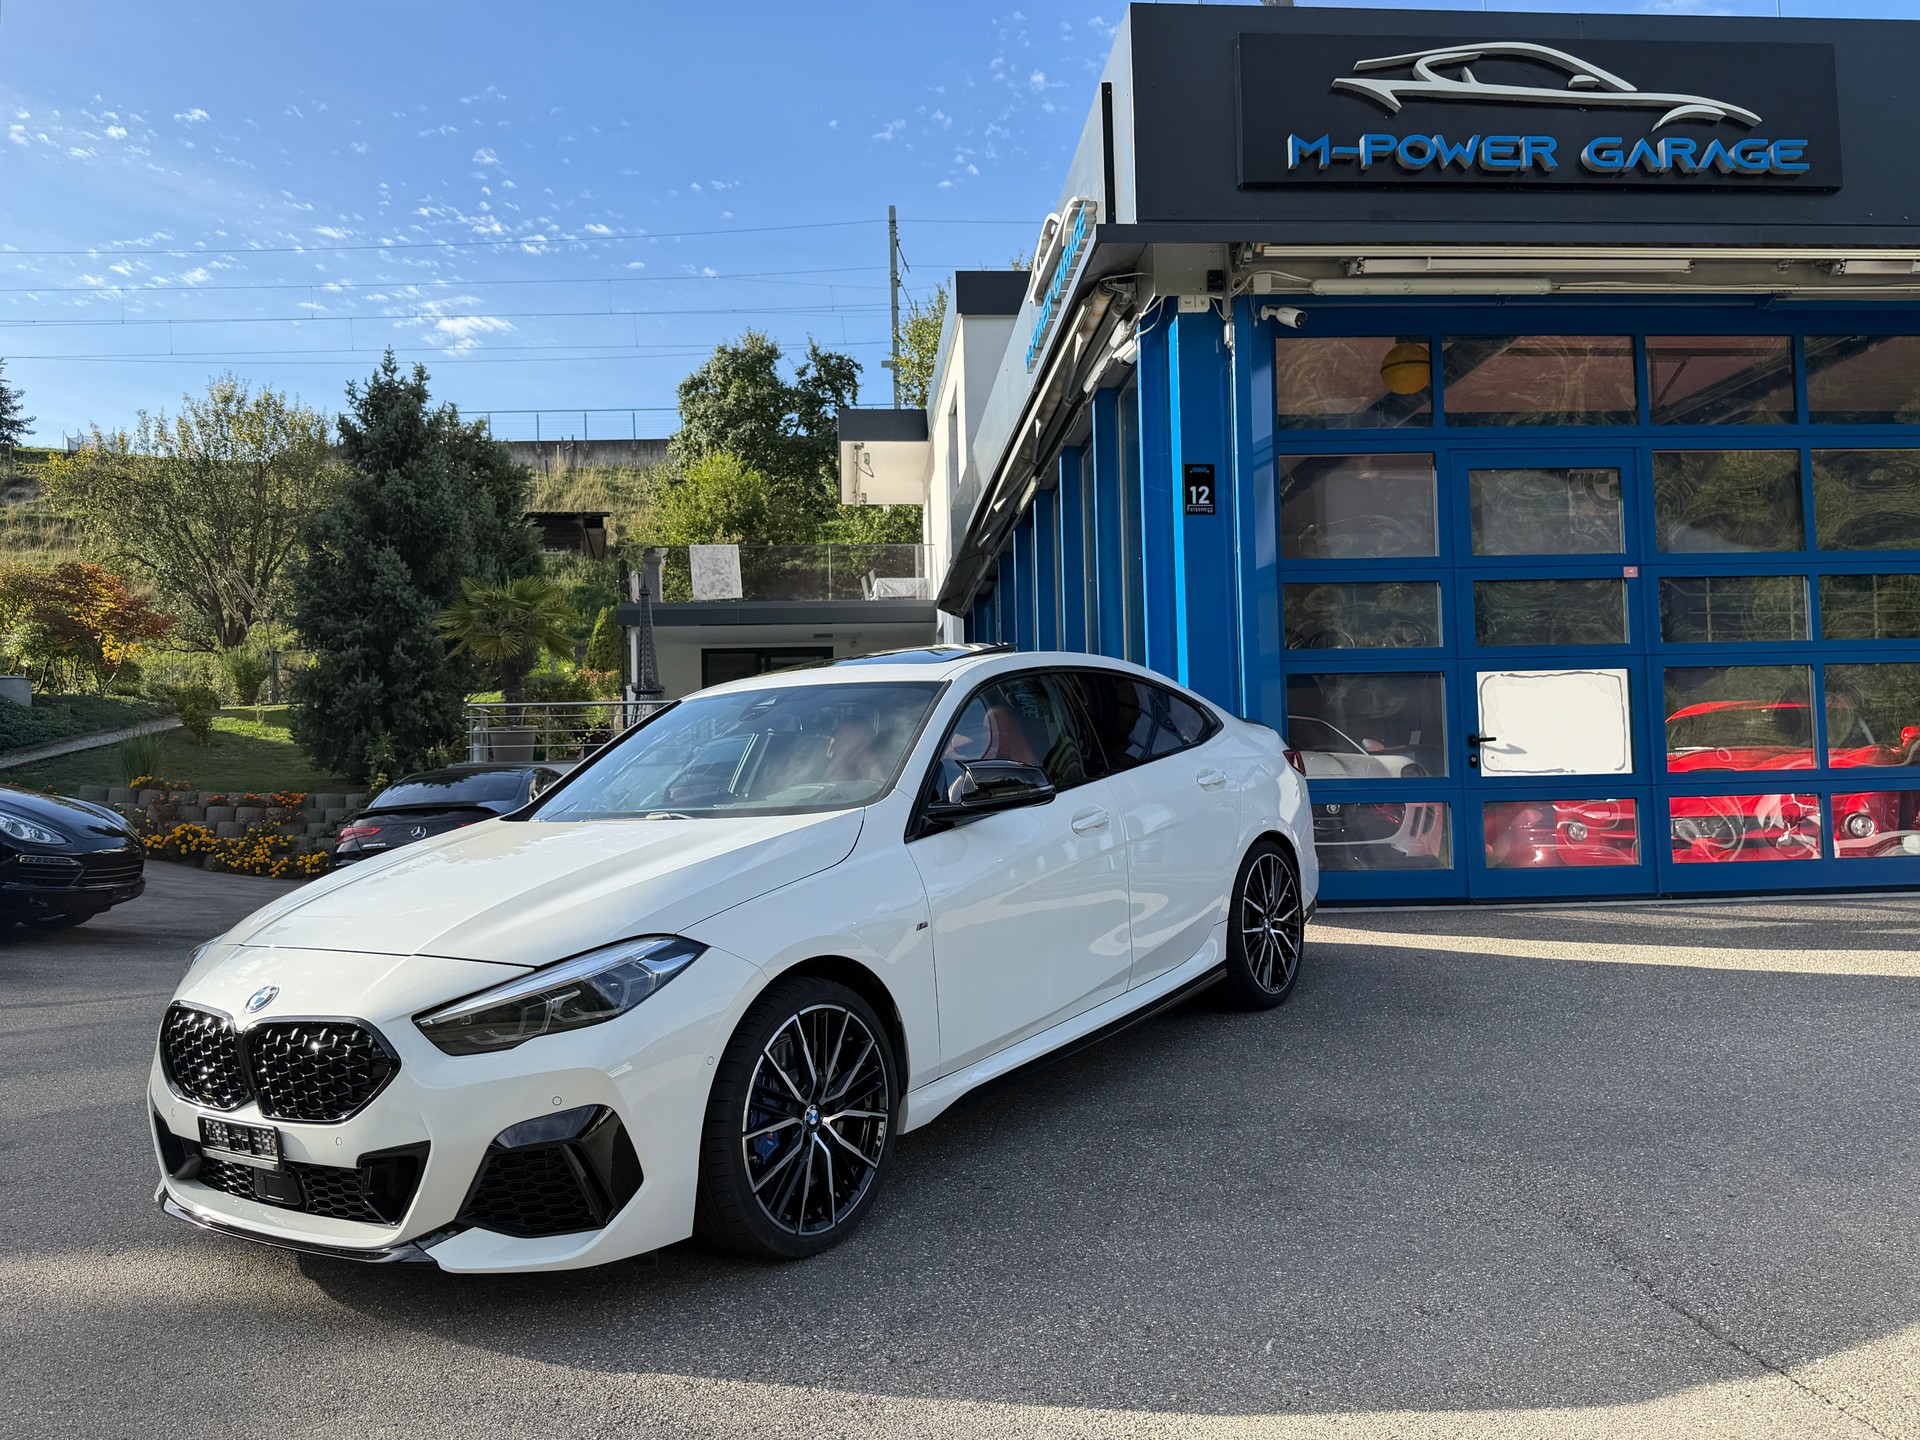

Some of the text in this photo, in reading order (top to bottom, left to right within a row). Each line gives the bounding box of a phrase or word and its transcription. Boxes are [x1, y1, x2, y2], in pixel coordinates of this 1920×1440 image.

[1287, 133, 1810, 174] M-POWER GARAGE
[1053, 200, 1086, 299] GARAGE
[1189, 485, 1210, 504] 12
